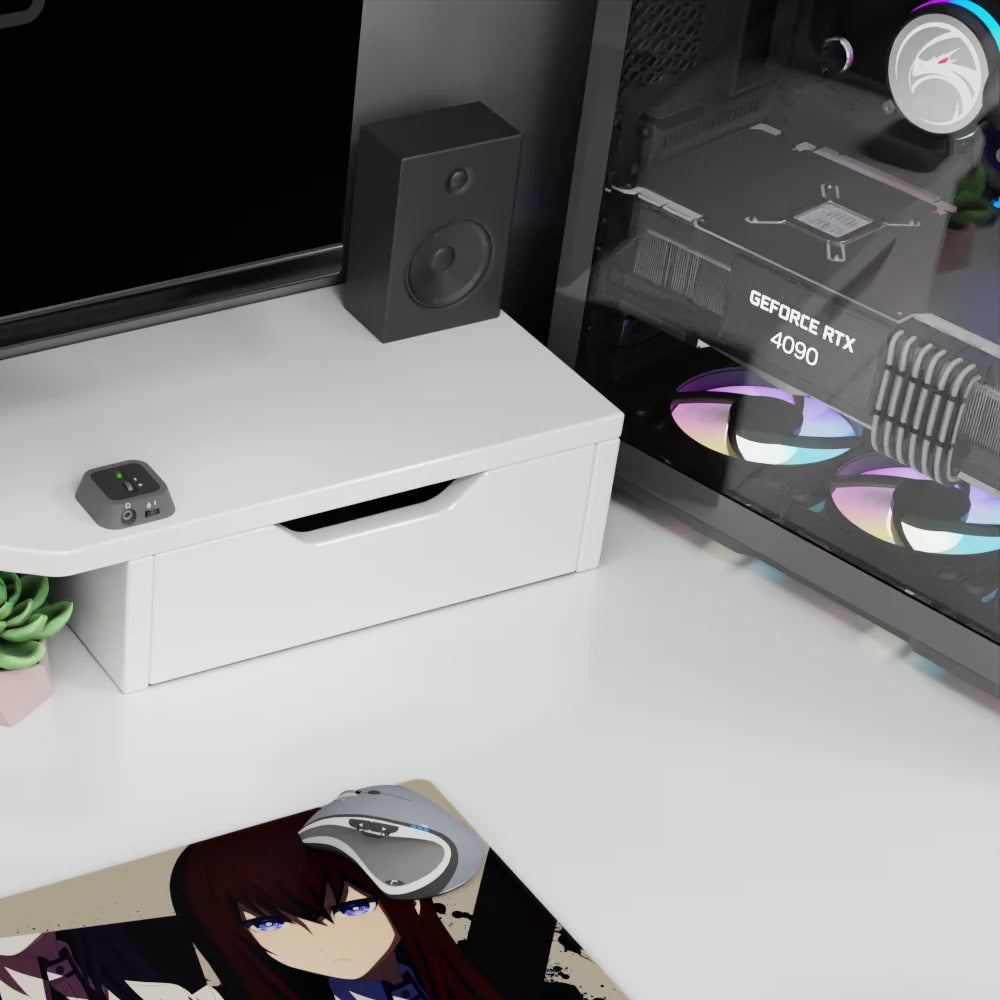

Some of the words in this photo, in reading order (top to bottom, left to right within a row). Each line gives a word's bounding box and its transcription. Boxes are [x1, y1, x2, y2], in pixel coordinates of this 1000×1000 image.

[749, 289, 820, 336] GEFORCE
[822, 325, 857, 354] RTX
[770, 331, 819, 367] 4090
